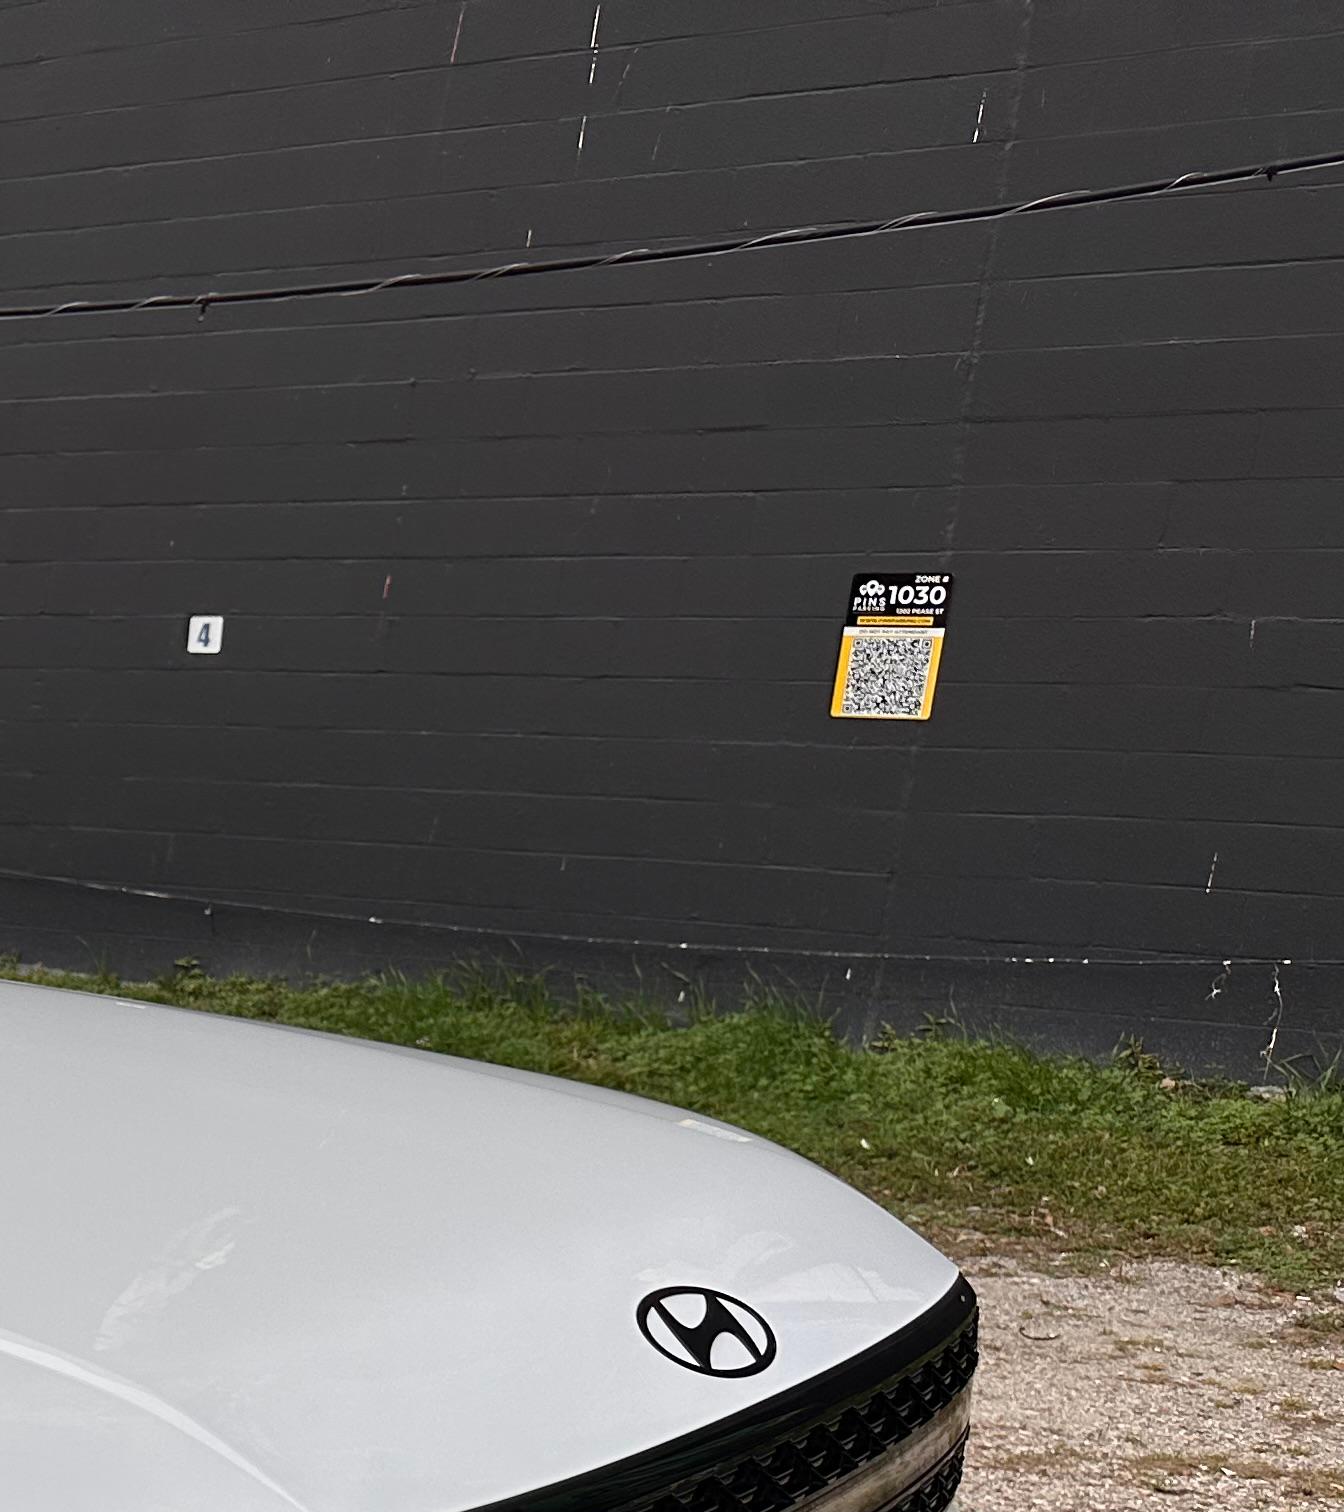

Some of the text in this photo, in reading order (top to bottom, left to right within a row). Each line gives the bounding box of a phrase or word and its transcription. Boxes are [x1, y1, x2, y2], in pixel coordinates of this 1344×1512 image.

[914, 575, 941, 584] ZONE
[853, 597, 886, 607] PINS
[888, 585, 947, 605] 1030
[196, 623, 210, 647] 4
